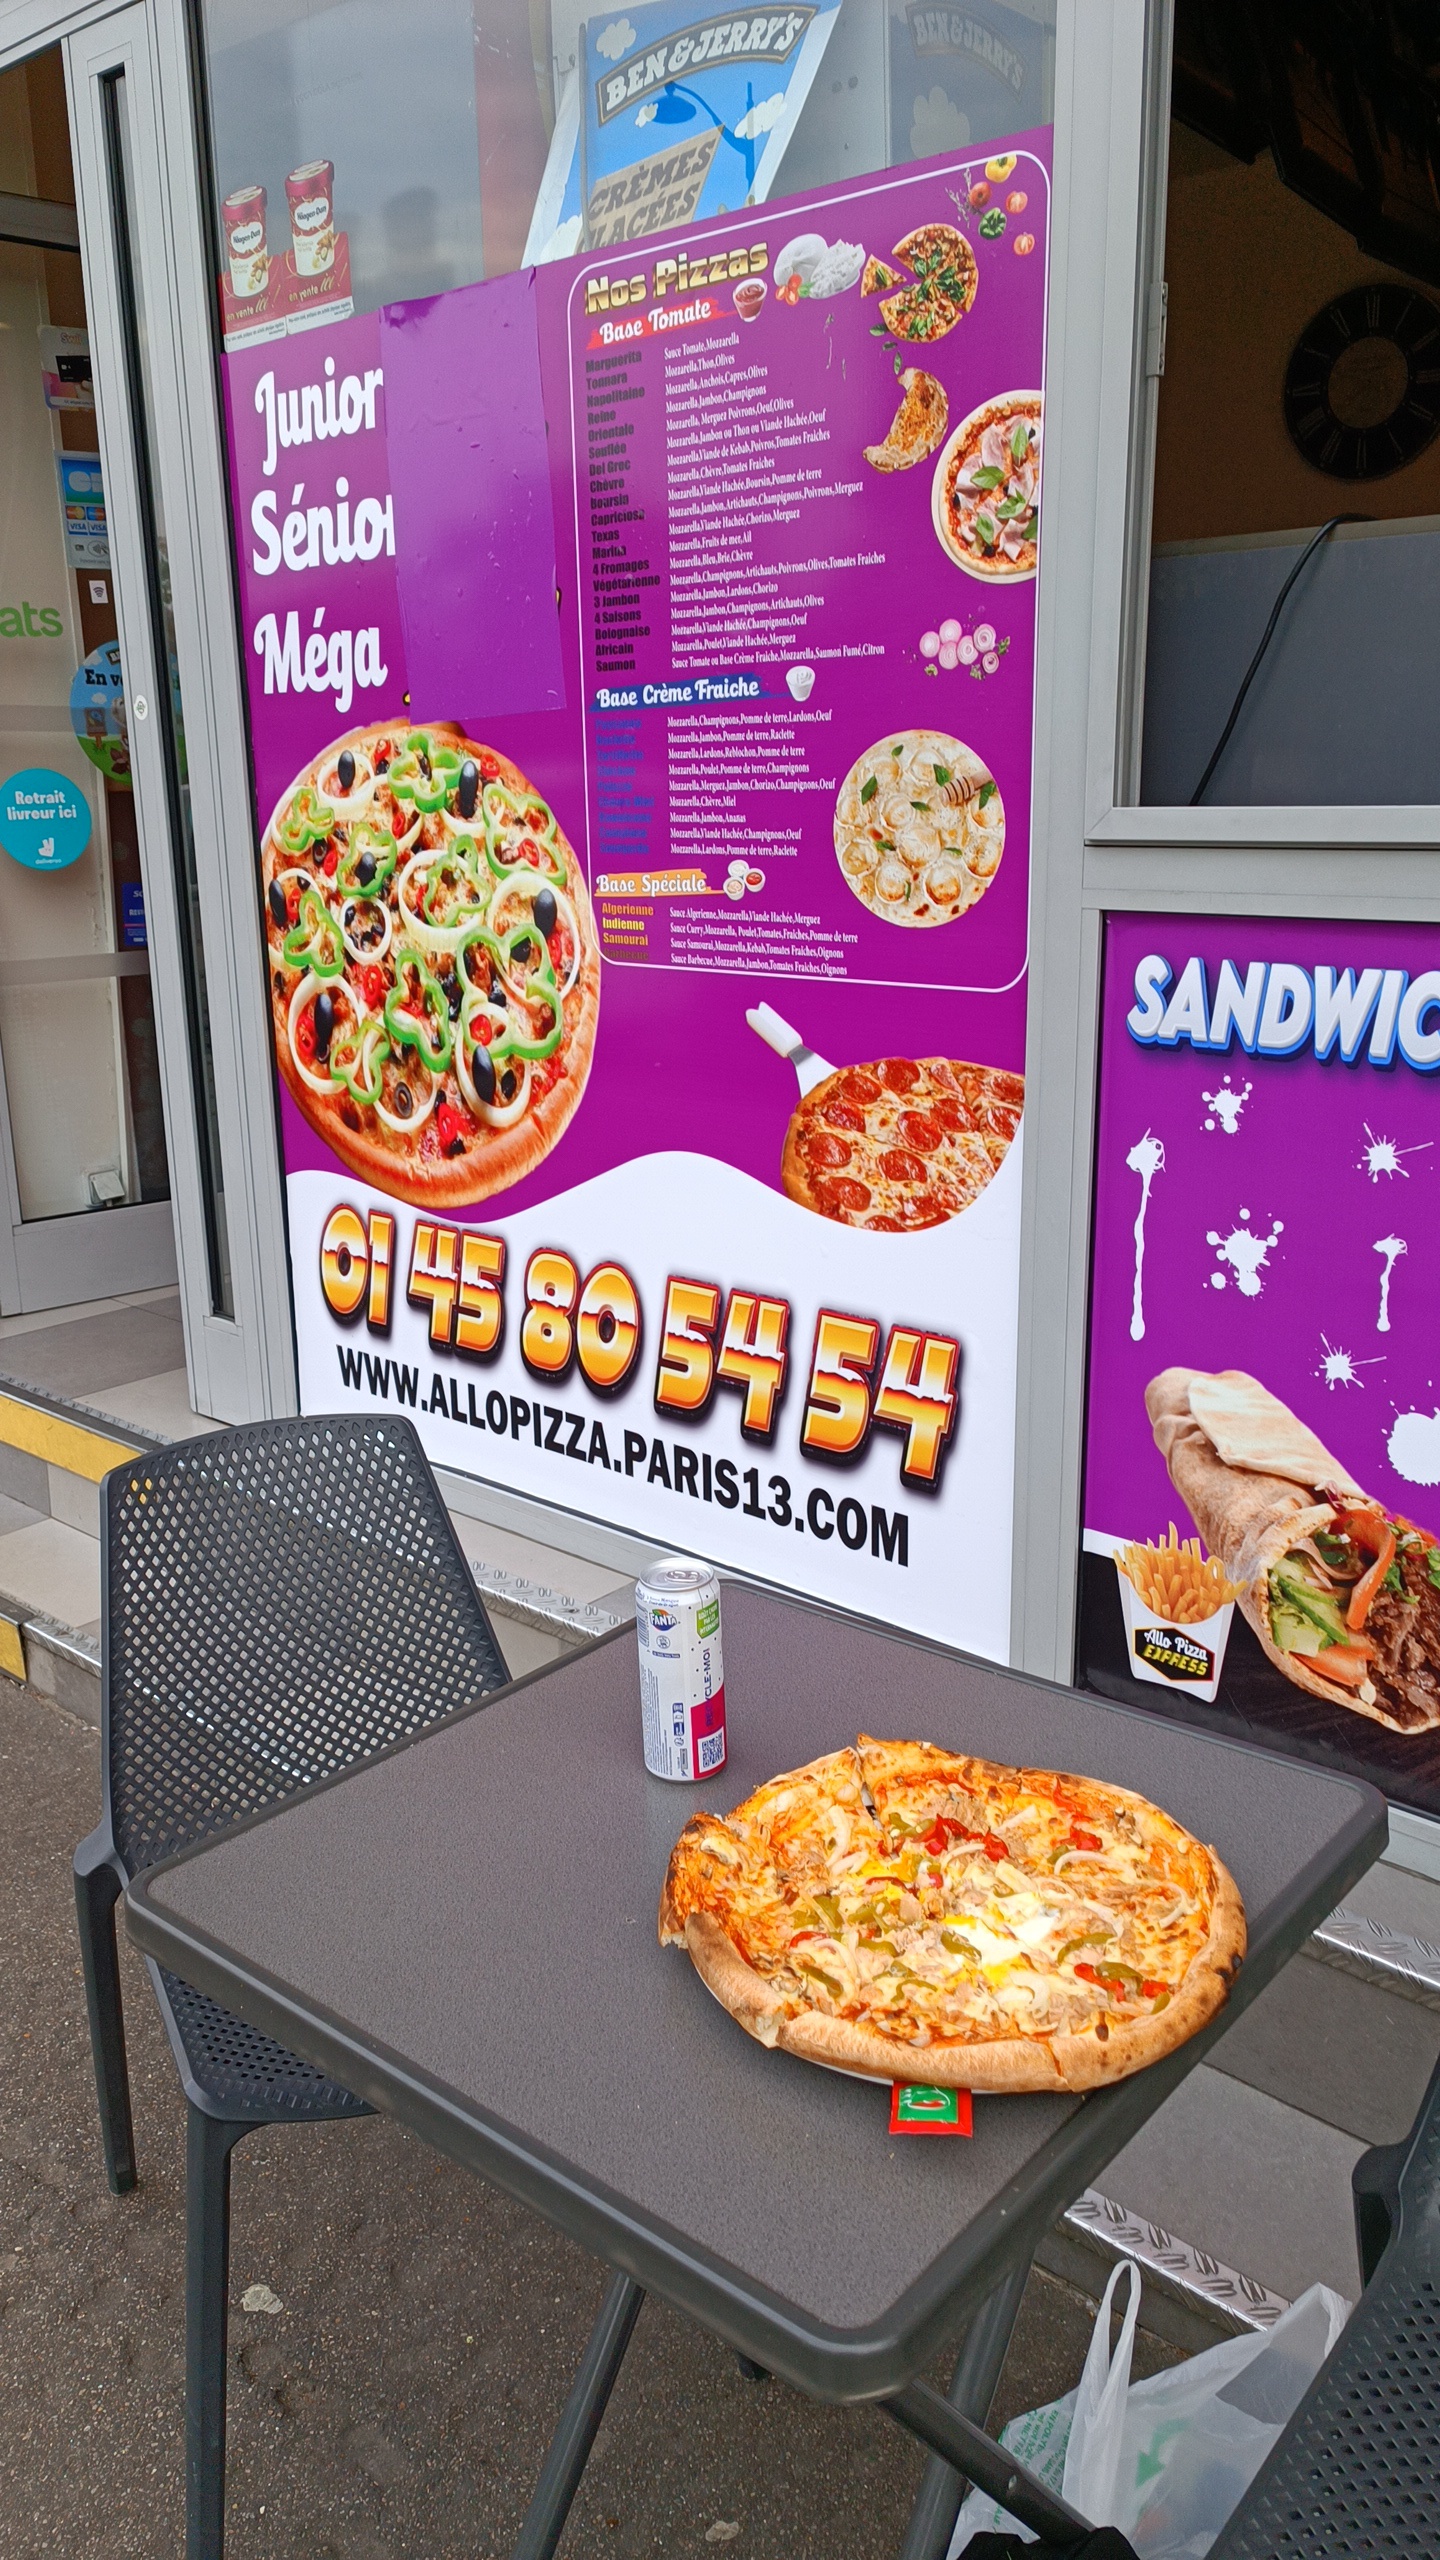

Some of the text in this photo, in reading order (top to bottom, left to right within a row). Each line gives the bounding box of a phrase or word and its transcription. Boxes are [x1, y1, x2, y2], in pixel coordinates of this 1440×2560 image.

[588, 138, 717, 220] CRÈMES
[585, 242, 769, 315] Nos Pizzas
[599, 299, 712, 344] Base Tomate
[585, 350, 642, 373] Marguerita
[665, 348, 681, 360] Sauce
[254, 356, 384, 477] Junior
[702, 412, 726, 426] Merguez
[588, 423, 634, 442] Orientale
[724, 426, 734, 438] ou
[733, 424, 750, 436] Thon
[751, 421, 761, 433] ou
[760, 417, 782, 431] Viande
[721, 446, 729, 457] de
[797, 469, 805, 481] de
[806, 469, 822, 480] terre
[590, 493, 629, 510] Boursin
[70, 523, 87, 531] VISA
[591, 529, 620, 543] Texas
[720, 535, 728, 545] de
[729, 530, 751, 544] mer,Ail
[593, 559, 649, 576] 4 Fromages
[593, 574, 661, 592] Végétarienne
[594, 593, 640, 608] 3 Jambon
[594, 610, 642, 624] 4 Saisons
[595, 625, 651, 641] Bolognaise
[595, 642, 634, 657] Africain
[253, 606, 389, 714] Méga
[596, 659, 636, 672] Saumon
[672, 657, 690, 668] Sauce
[689, 657, 712, 667] Tomate
[720, 654, 733, 665] Base
[734, 653, 754, 664] Crème
[84, 668, 108, 686] En
[596, 677, 760, 709] Base Crème Fraiche
[764, 712, 771, 723] de
[746, 730, 755, 740] de
[781, 745, 789, 756] de
[790, 747, 805, 756] terre
[743, 763, 750, 773] de
[15, 790, 66, 805] Retrait
[7, 804, 77, 821] livreur ici
[749, 845, 757, 855] de
[596, 872, 707, 897] Base Spéciale
[602, 902, 654, 916] Algerienne
[670, 907, 686, 918] Sauce
[602, 916, 645, 931] Indienne
[603, 932, 649, 946] Samourai
[670, 922, 685, 933] Sauce
[834, 931, 842, 942] de
[843, 933, 858, 943] terre
[670, 938, 687, 949] Sauce
[671, 953, 687, 965] Sauce
[321, 1203, 962, 1496] 01 45 80 54 54
[335, 1344, 909, 1567] WWW.ALLOPIZZA.PARIS13.COM
[650, 1614, 677, 1626] FANTA
[1143, 1628, 1208, 1661] Allo Pizza
[1143, 1643, 1209, 1676] EXPRESS
